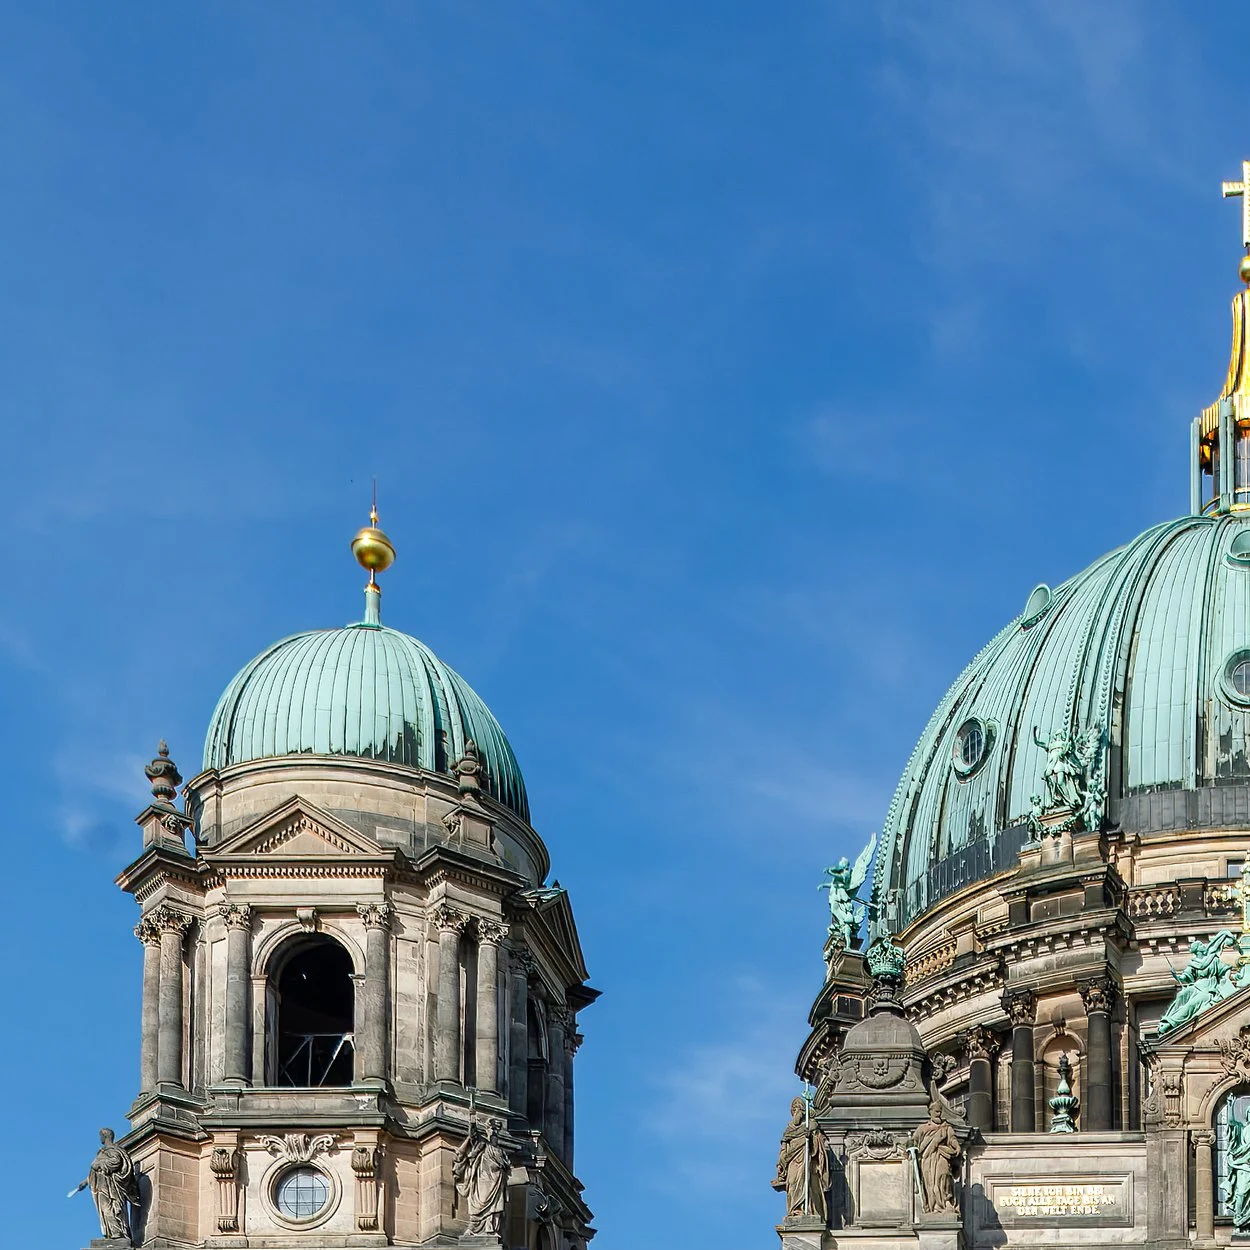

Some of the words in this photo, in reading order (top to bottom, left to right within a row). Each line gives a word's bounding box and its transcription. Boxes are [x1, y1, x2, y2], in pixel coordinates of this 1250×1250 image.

[1029, 1196, 1053, 1206] ALLE
[1056, 1196, 1081, 1206] TAGE
[1083, 1196, 1100, 1205] BIS
[1102, 1195, 1116, 1205] AN
[1018, 1206, 1038, 1216] DER
[1042, 1206, 1067, 1216] WELT
